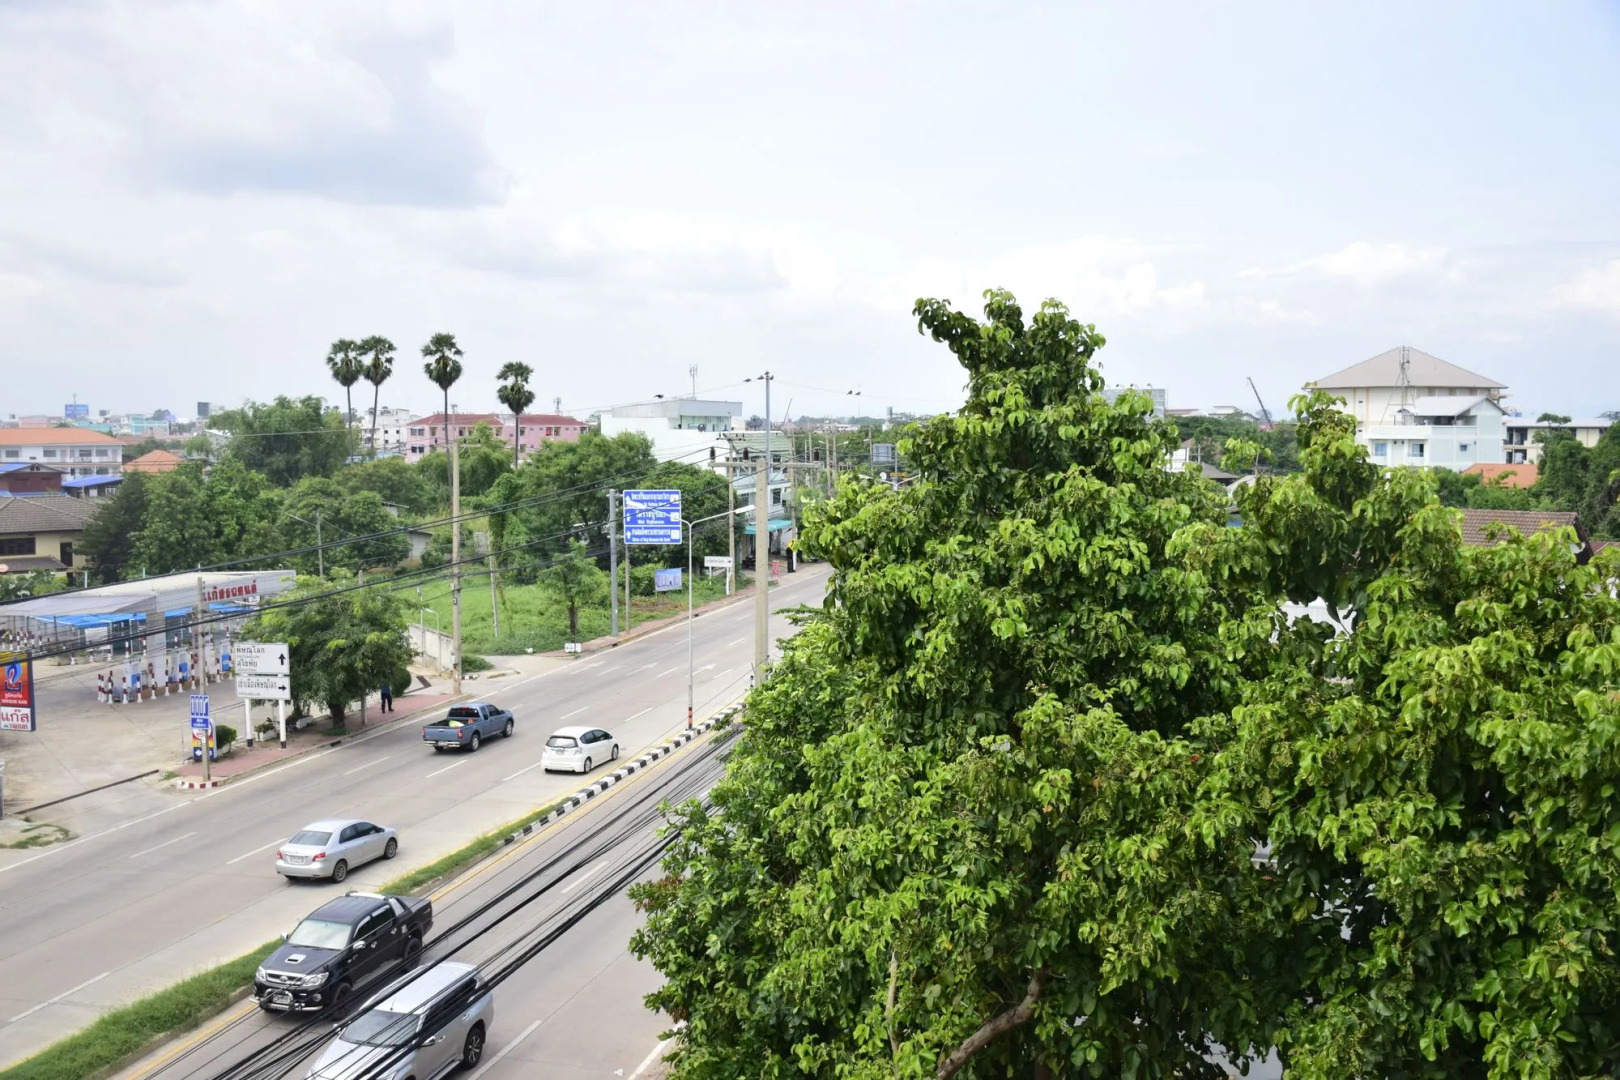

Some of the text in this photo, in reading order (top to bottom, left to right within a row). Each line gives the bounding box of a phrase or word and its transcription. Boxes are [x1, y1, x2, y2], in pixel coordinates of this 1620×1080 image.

[236, 646, 265, 655] พิษณุโลก
[1, 709, 29, 722] แก๊ส
